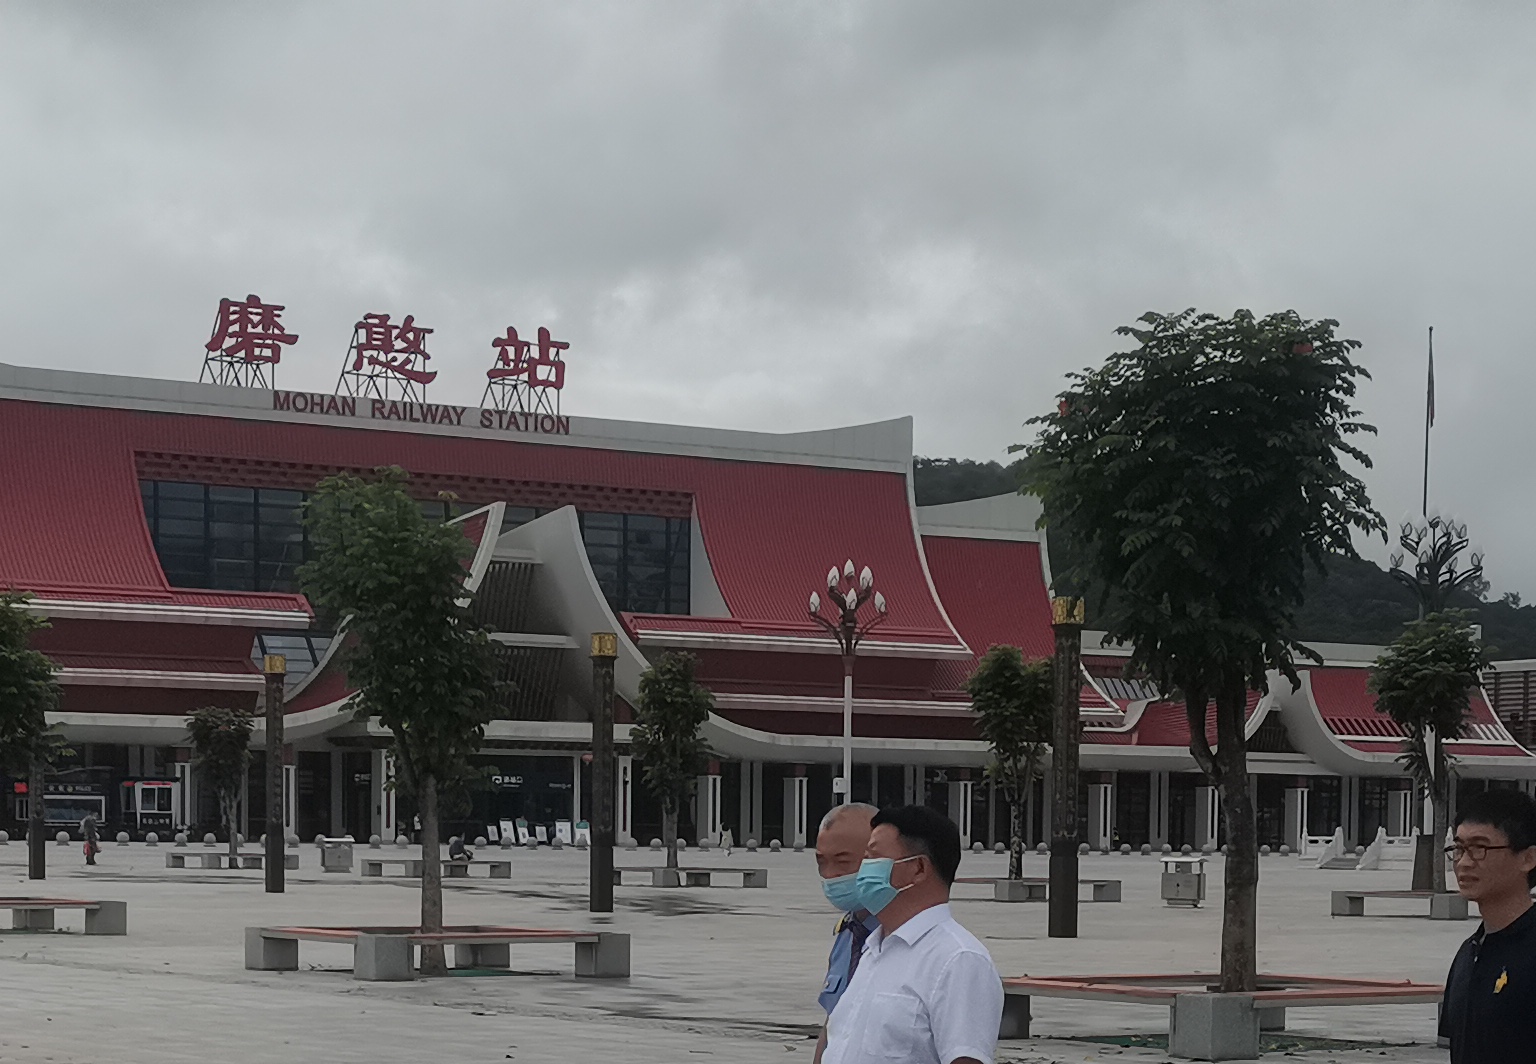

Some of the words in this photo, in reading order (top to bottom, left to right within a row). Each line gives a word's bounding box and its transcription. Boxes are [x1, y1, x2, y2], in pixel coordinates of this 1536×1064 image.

[205, 294, 570, 390] 磨憨站
[273, 390, 356, 417] MOHAN
[371, 399, 467, 427] RAILWAY
[479, 410, 571, 435] STATION
